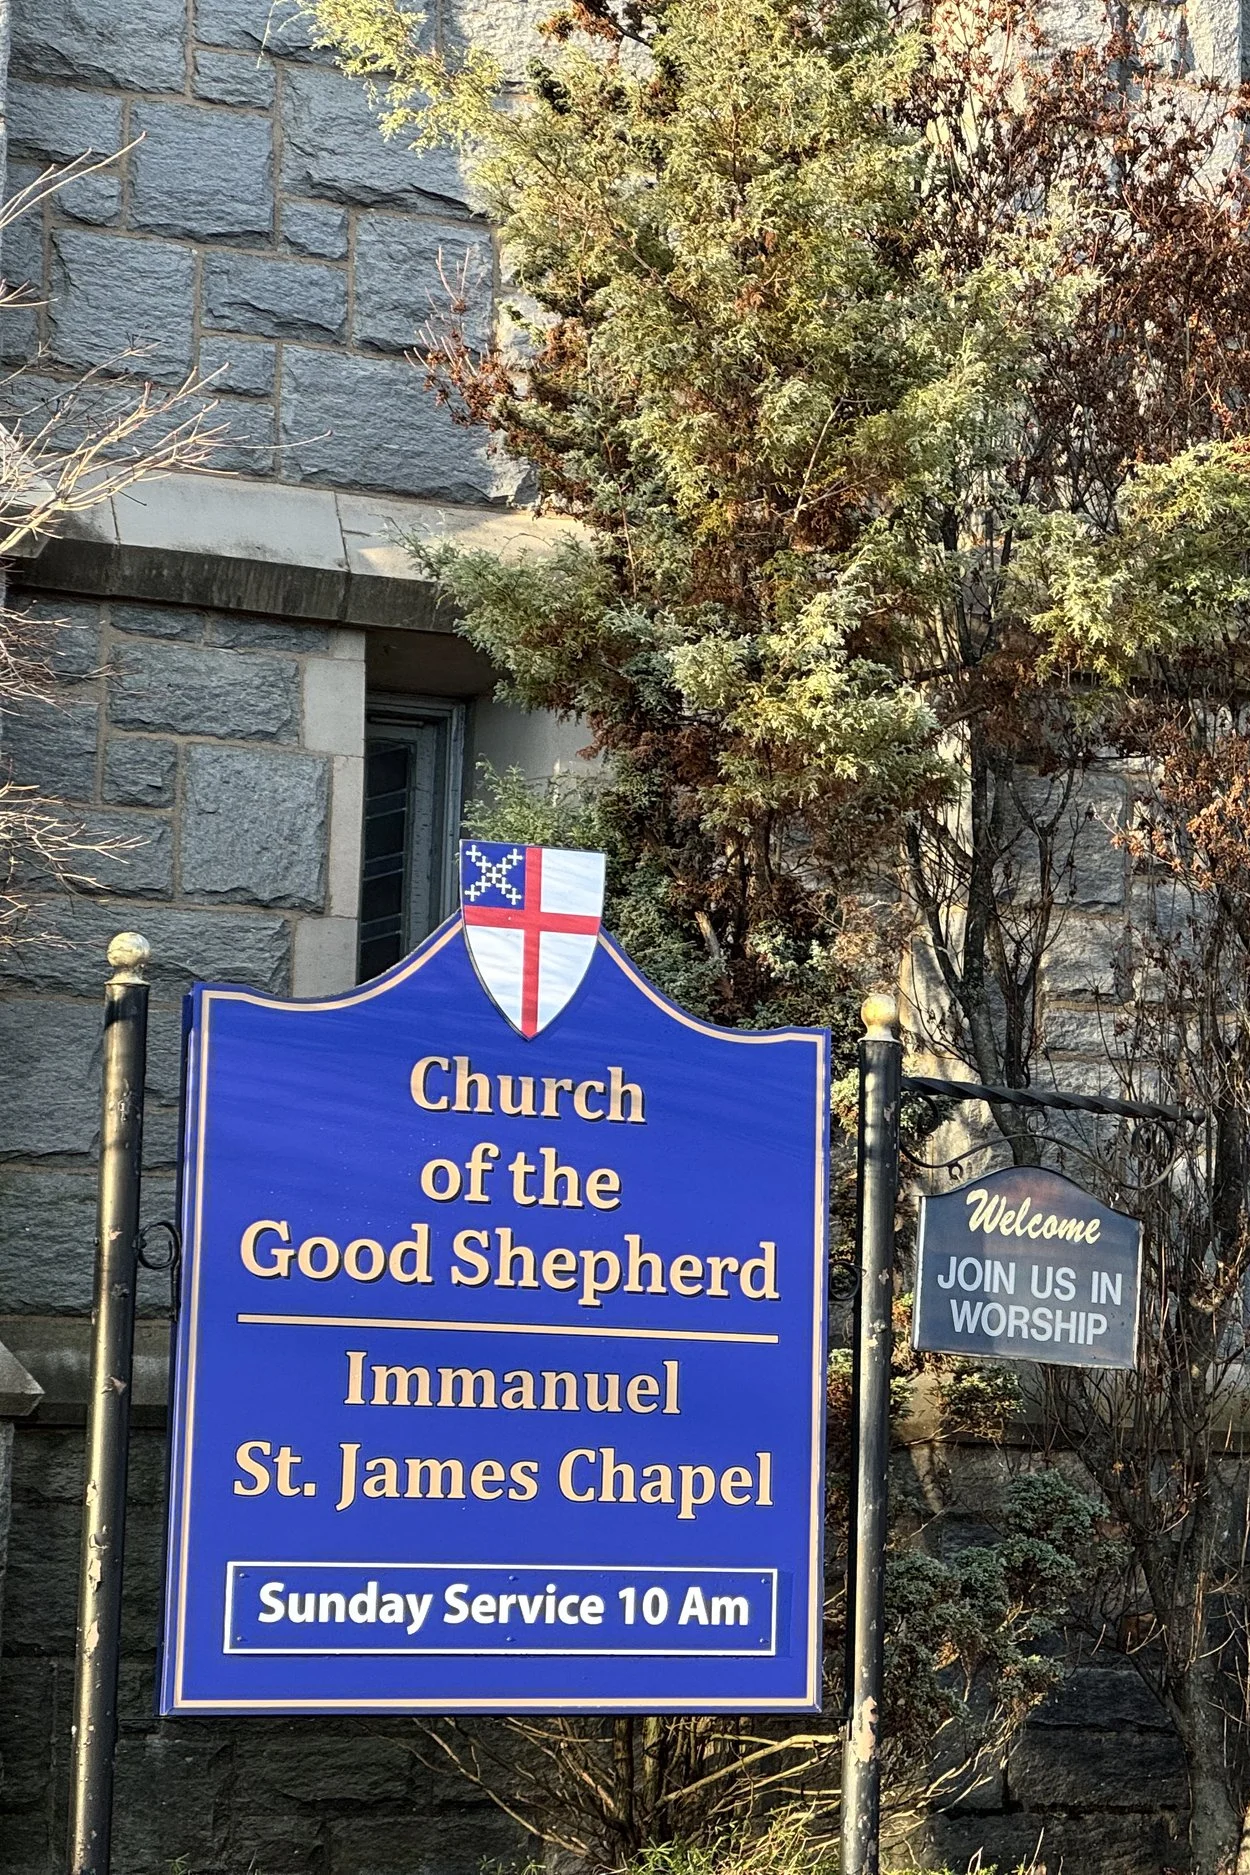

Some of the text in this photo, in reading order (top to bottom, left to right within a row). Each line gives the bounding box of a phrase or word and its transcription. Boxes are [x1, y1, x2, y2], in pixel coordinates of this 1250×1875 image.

[410, 1056, 646, 1122] Church
[420, 1142, 621, 1209] of the
[967, 1189, 1100, 1244] Welcome
[240, 1220, 779, 1305] Good Shepherd
[938, 1256, 1122, 1305] JOIN US IN
[950, 1299, 1107, 1345] WORSHIP
[345, 1350, 680, 1414] Immanuel
[233, 1440, 773, 1520] St. James Chapel
[258, 1582, 749, 1634] Sunday Service 10 Am
